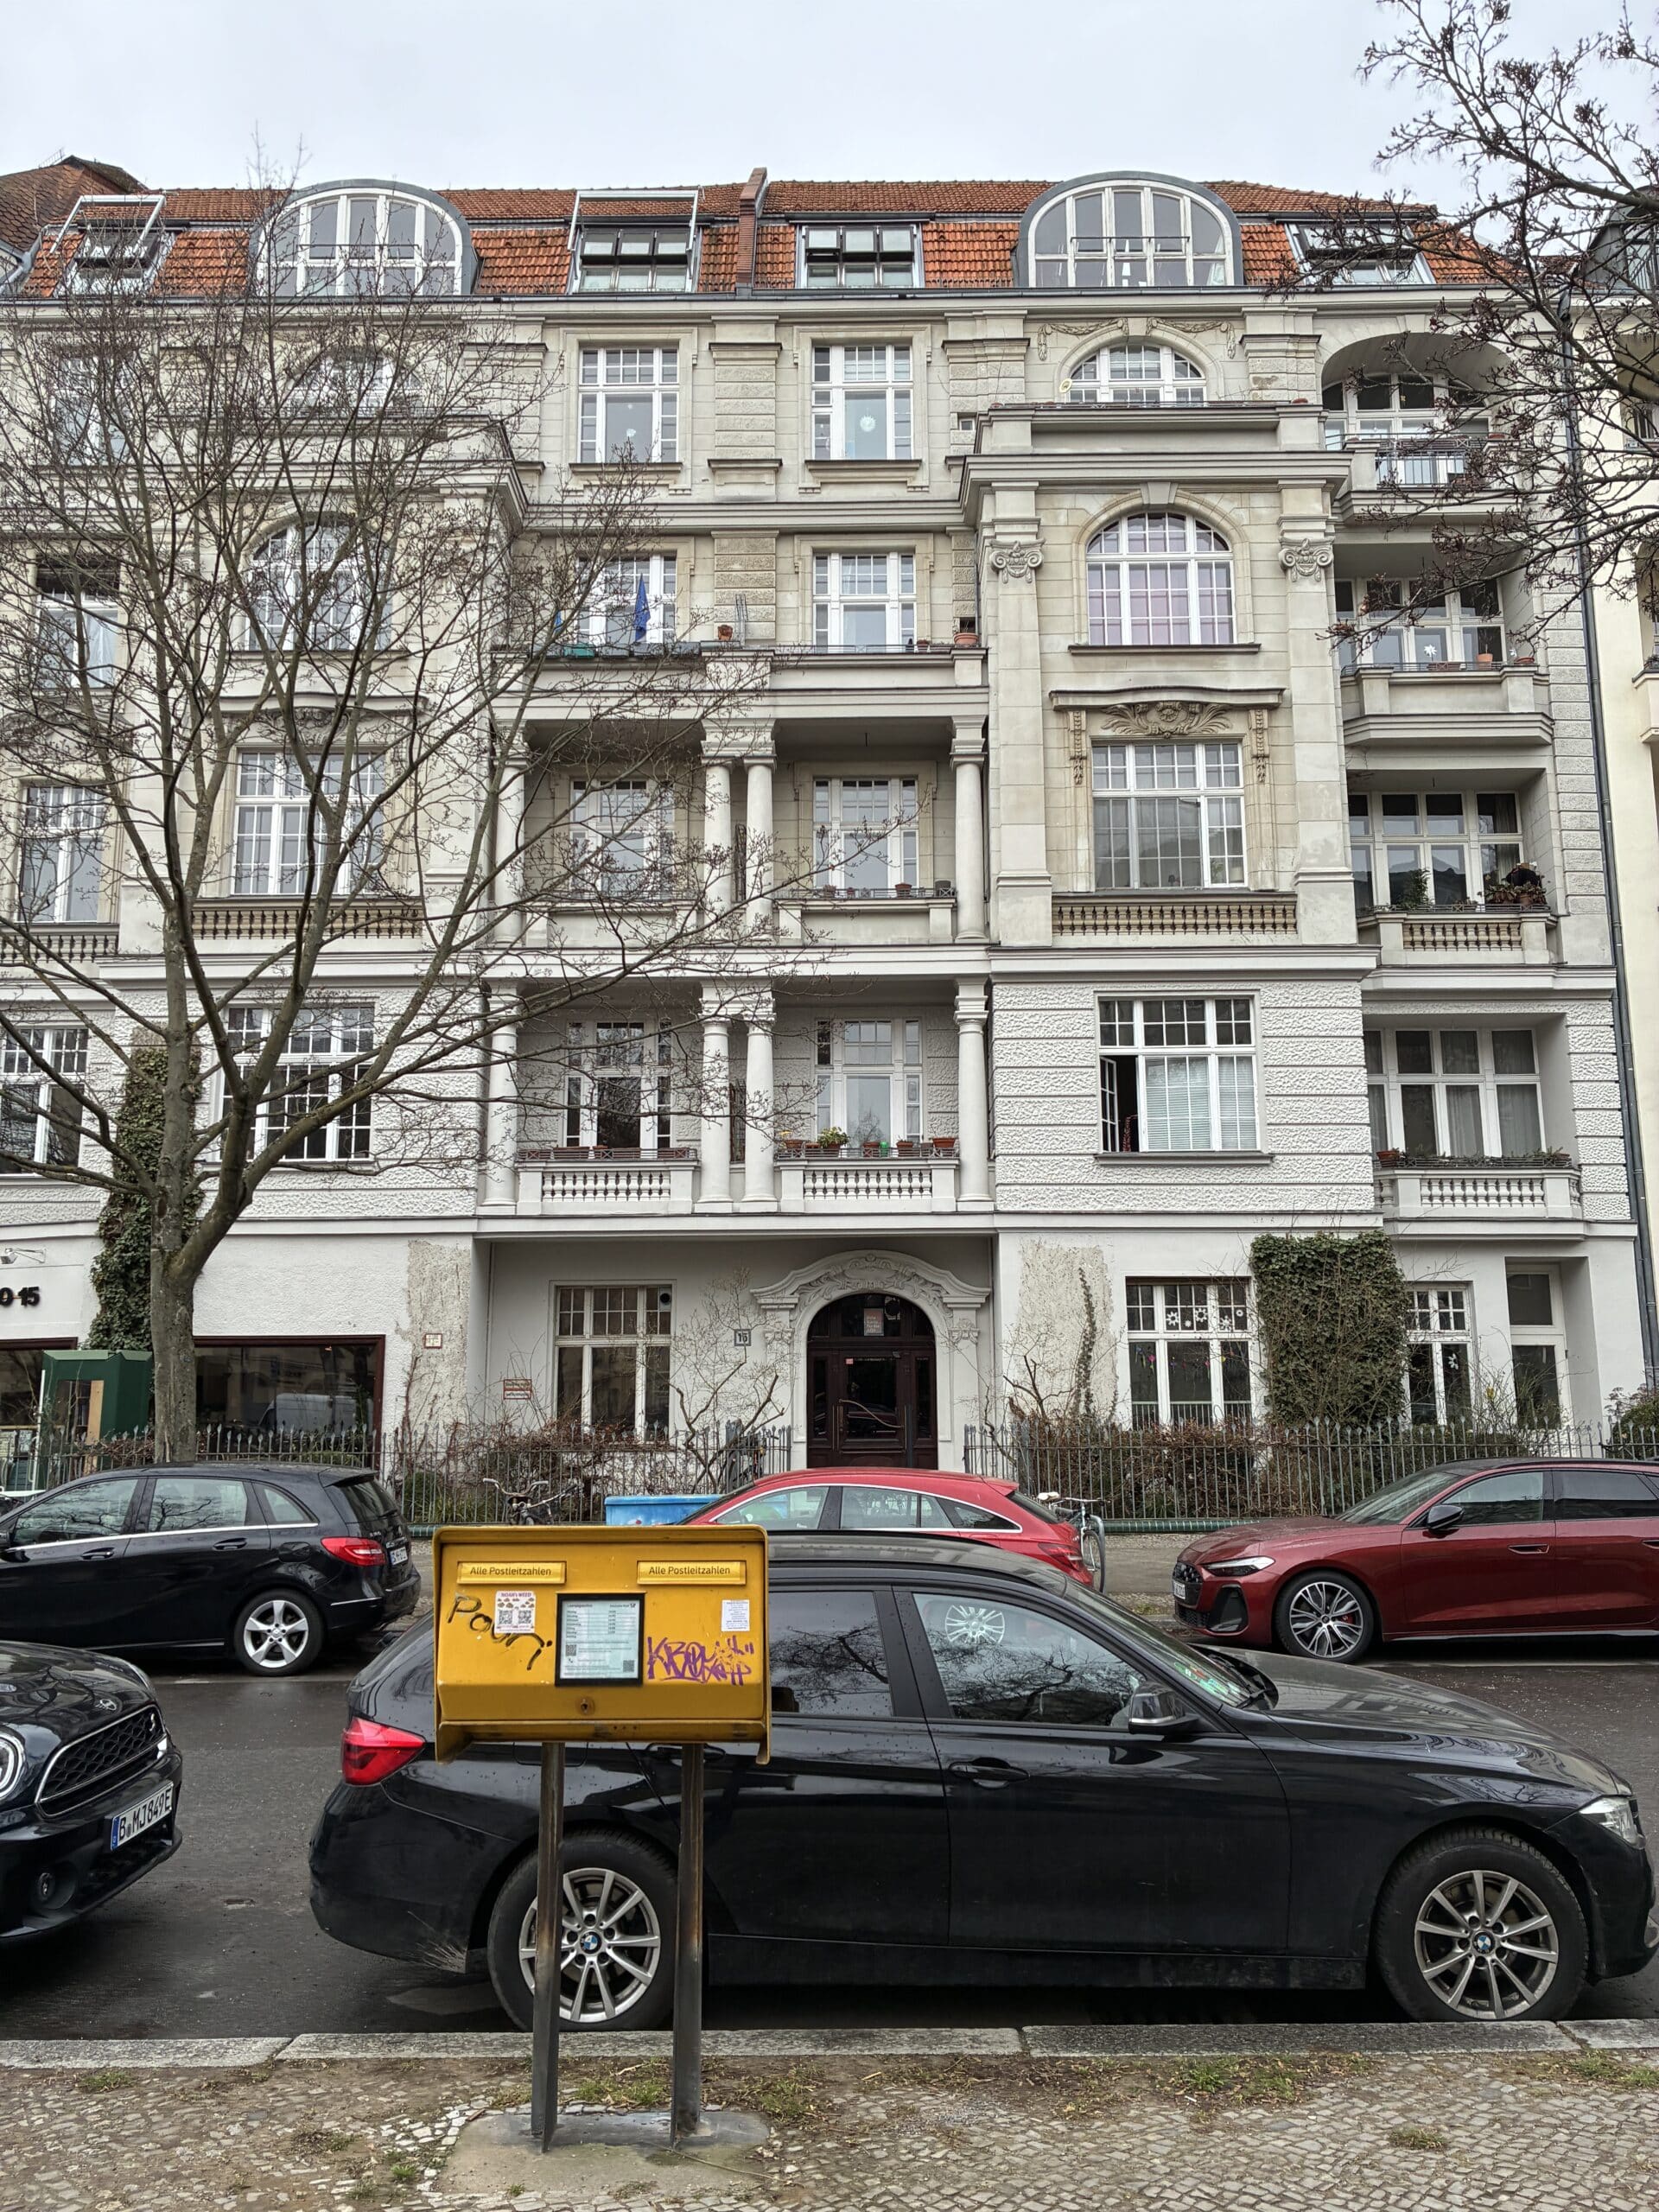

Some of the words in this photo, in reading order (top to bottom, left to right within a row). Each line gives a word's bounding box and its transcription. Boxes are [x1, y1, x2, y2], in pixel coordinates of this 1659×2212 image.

[470, 1567, 487, 1576] Alle
[489, 1567, 551, 1576] Postleitzahlen
[649, 1566, 666, 1575] Alle
[668, 1566, 731, 1575] Postleitzahlen
